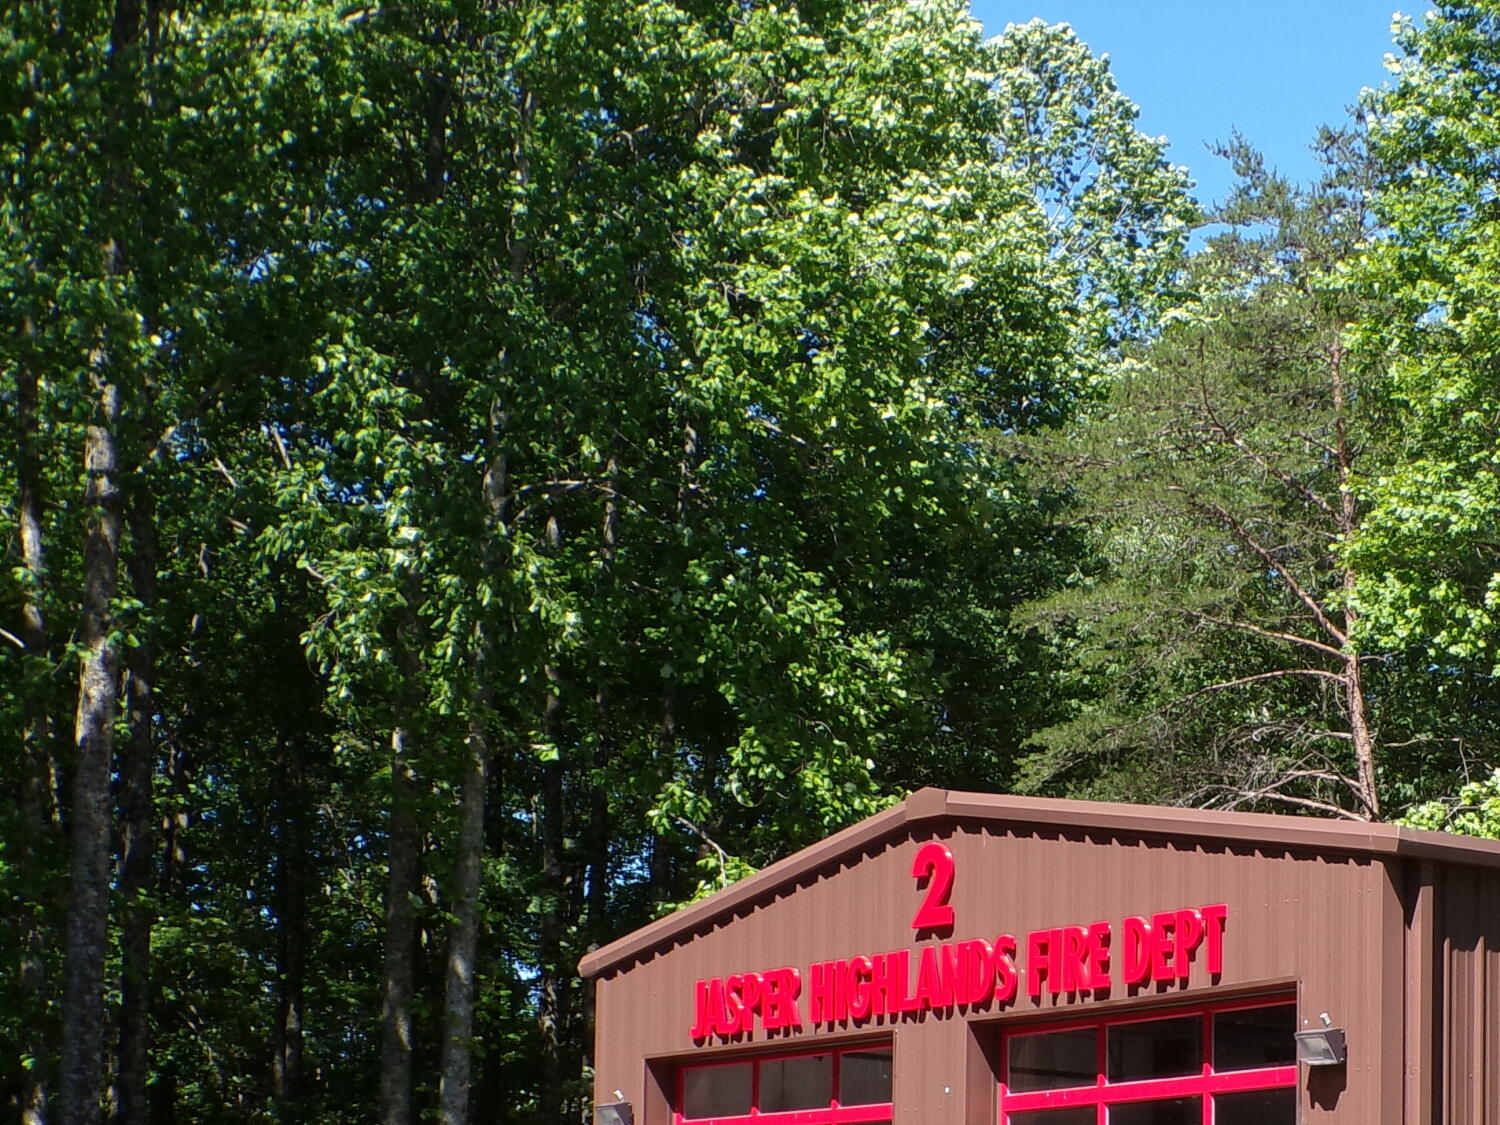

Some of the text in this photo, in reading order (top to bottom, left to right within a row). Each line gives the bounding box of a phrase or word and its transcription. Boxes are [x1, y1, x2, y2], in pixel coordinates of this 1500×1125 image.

[911, 842, 955, 929] 2
[689, 903, 1229, 1040] JASPER HIGHLANDS FIRE DEPT
